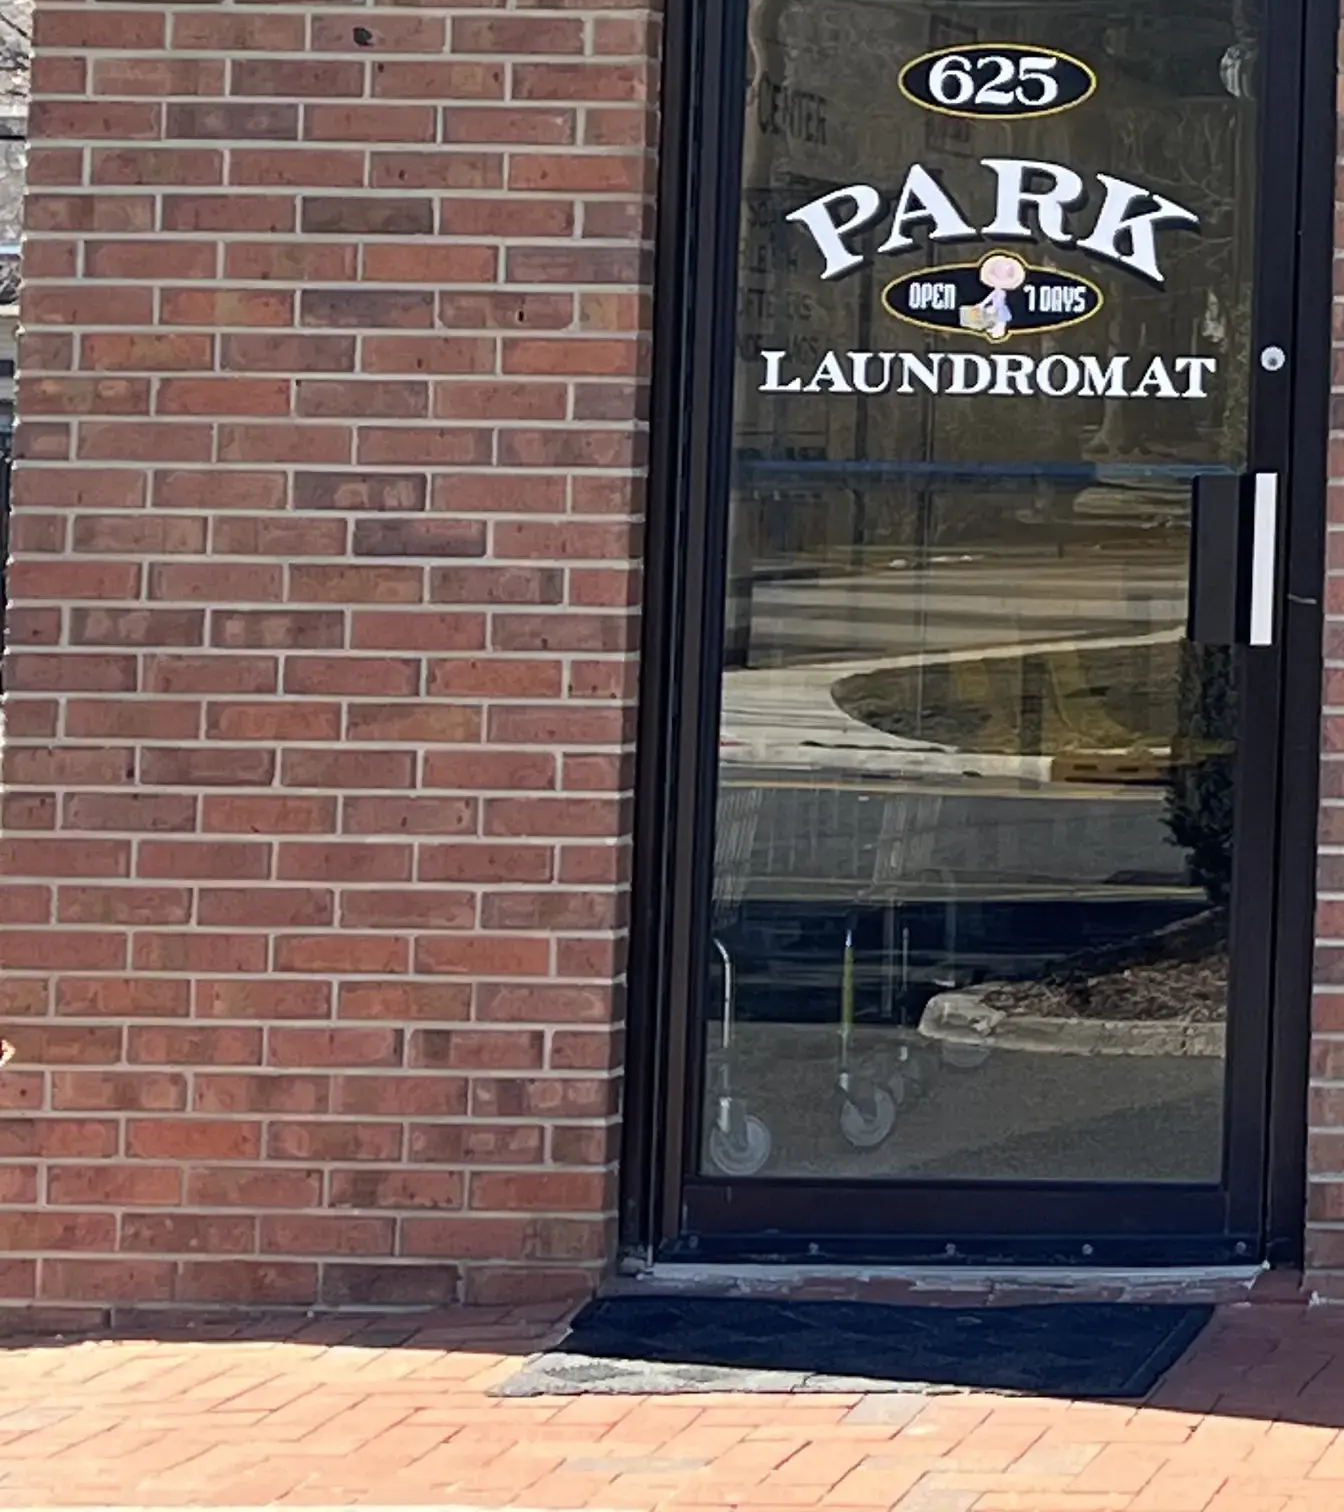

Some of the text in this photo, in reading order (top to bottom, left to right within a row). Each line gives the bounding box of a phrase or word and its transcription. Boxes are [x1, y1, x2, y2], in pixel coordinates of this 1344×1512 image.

[928, 54, 1060, 106] 625
[786, 158, 1199, 283] PARK
[908, 281, 957, 310] OPEN
[1038, 285, 1087, 313] DAYS
[758, 350, 1216, 399] LAUNDROMAT
